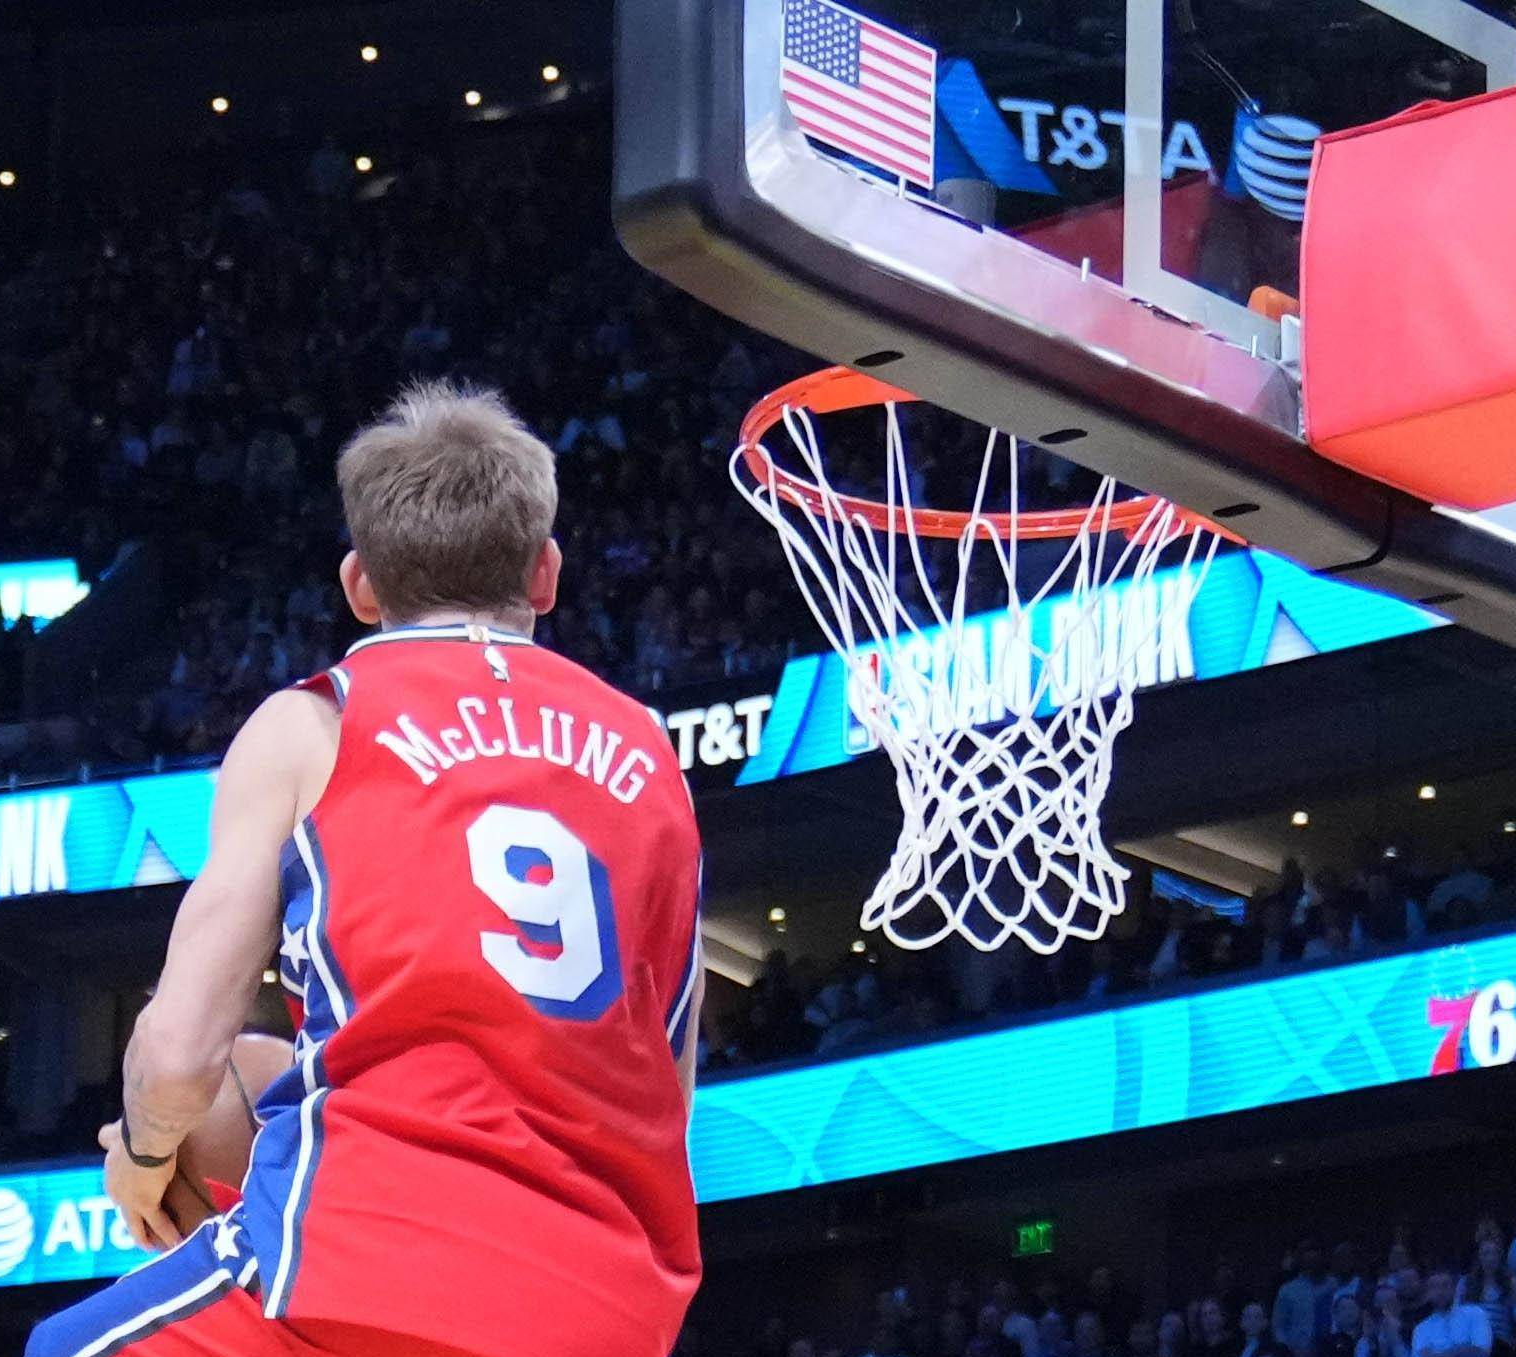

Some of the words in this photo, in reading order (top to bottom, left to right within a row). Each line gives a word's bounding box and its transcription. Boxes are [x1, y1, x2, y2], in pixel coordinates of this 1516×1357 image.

[374, 696, 656, 806] McCLUNG
[656, 696, 774, 772] T&T
[465, 804, 604, 1003] 9
